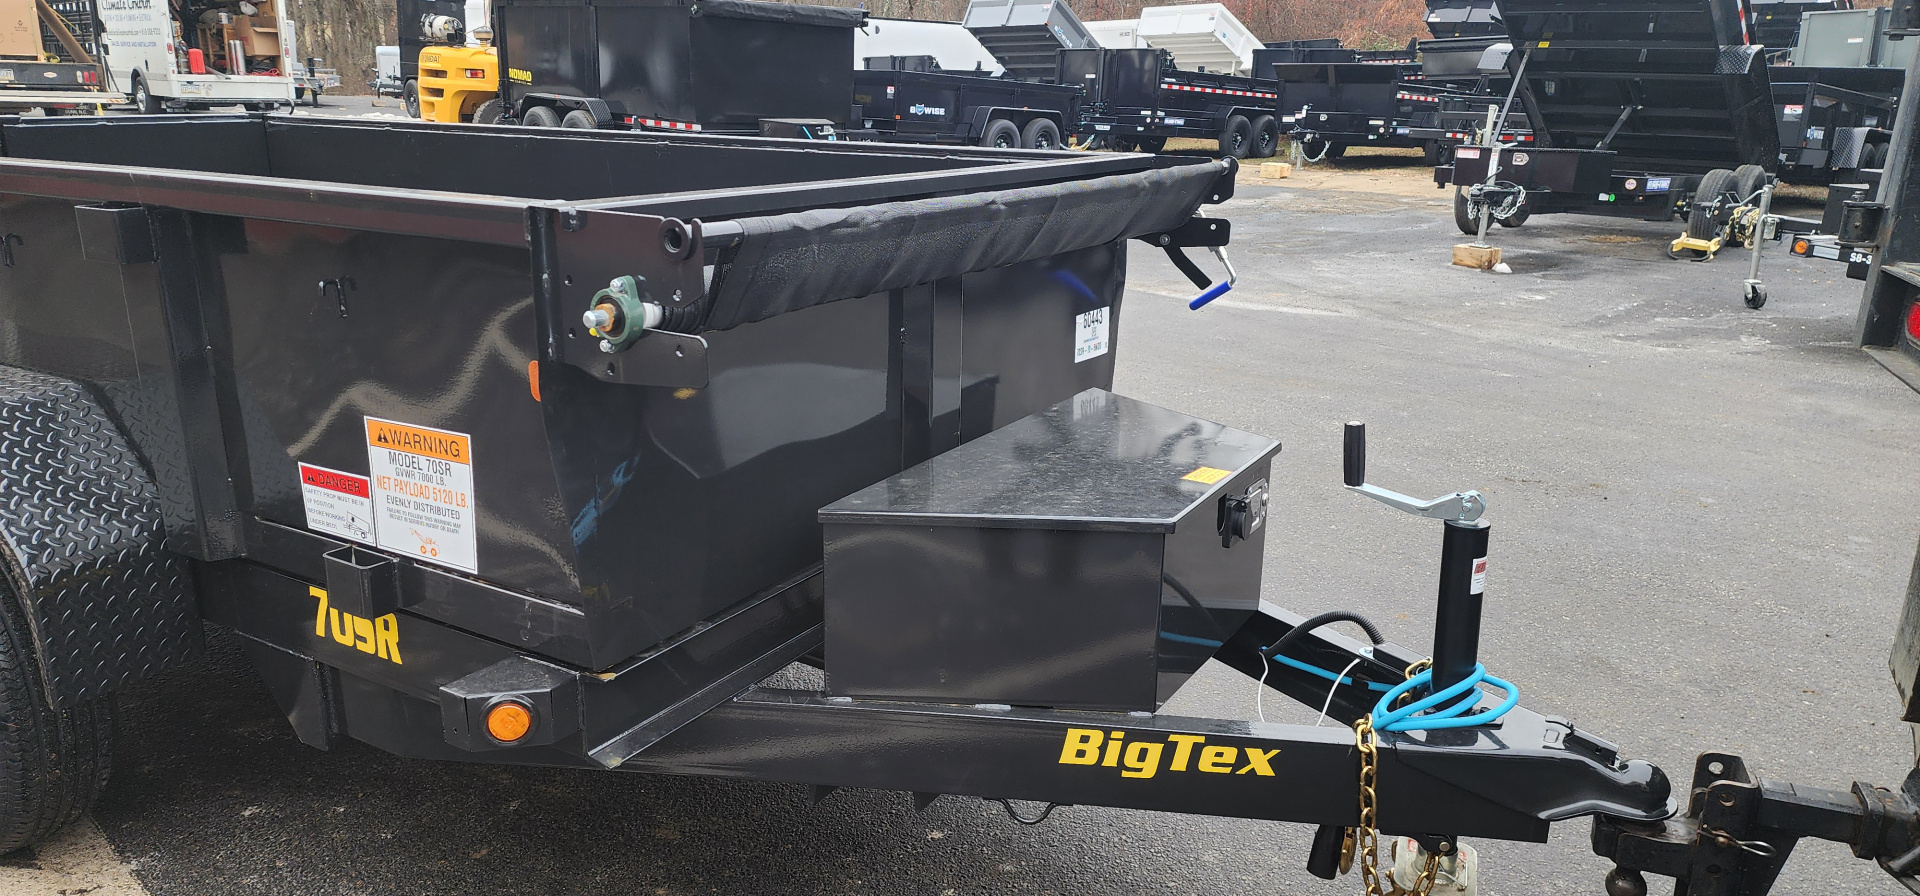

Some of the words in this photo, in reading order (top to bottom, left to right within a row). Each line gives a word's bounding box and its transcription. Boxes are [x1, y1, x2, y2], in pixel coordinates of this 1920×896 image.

[509, 67, 532, 82] NOMAD
[388, 428, 460, 458] WARNING
[388, 450, 423, 471] MODEL
[425, 458, 452, 477] 70SR
[318, 472, 361, 494] DANGER
[395, 466, 416, 480] GVWR
[417, 471, 434, 484] 7000
[436, 476, 447, 487] LB.
[305, 487, 323, 496] SAFETY
[376, 474, 391, 491] NET
[393, 478, 430, 500] PAYLOAD
[432, 486, 453, 505] 5120
[455, 491, 469, 509] LB.
[307, 507, 325, 517] BEFORE
[324, 511, 346, 523] WORKING
[313, 499, 335, 510] POSITION
[386, 494, 412, 509] EVENLY
[413, 500, 460, 521] DISTRIBUTED
[1058, 727, 1282, 779] BigTex
